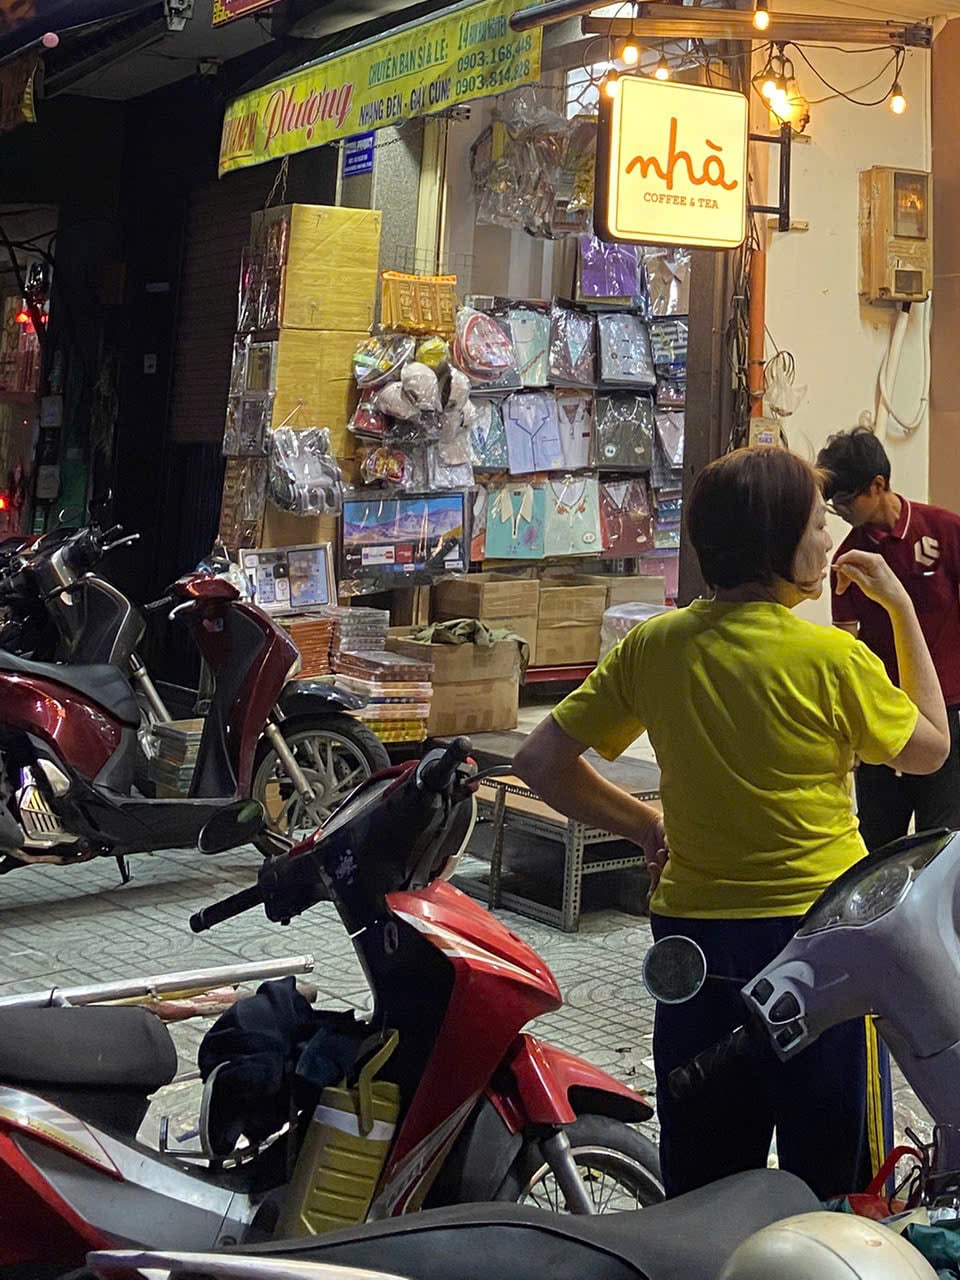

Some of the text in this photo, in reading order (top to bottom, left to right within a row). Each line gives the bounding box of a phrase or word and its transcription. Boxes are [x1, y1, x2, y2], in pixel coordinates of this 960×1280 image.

[625, 117, 738, 190] nhà
[643, 192, 719, 209] COFFEE & TEA
